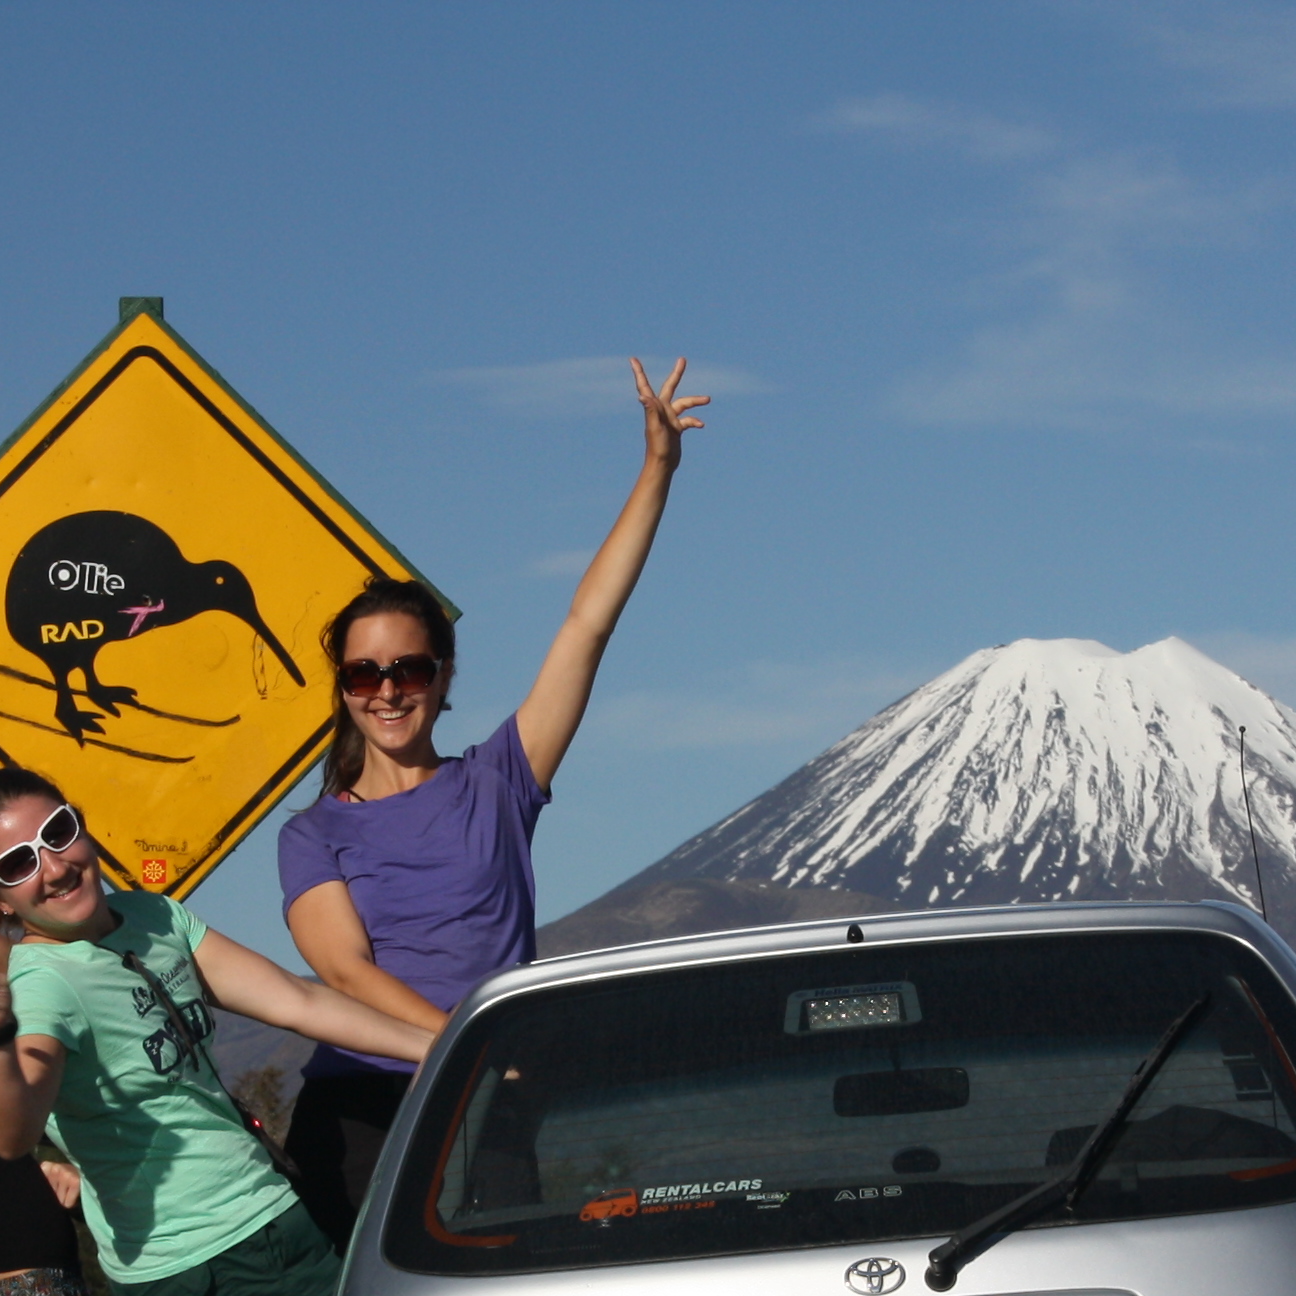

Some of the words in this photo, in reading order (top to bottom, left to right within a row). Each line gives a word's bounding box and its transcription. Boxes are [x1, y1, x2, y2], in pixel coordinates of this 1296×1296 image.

[40, 619, 104, 645] RAD
[642, 1179, 763, 1200] RENTALCARS
[834, 1185, 902, 1202] ABS
[641, 1204, 669, 1214] 0800
